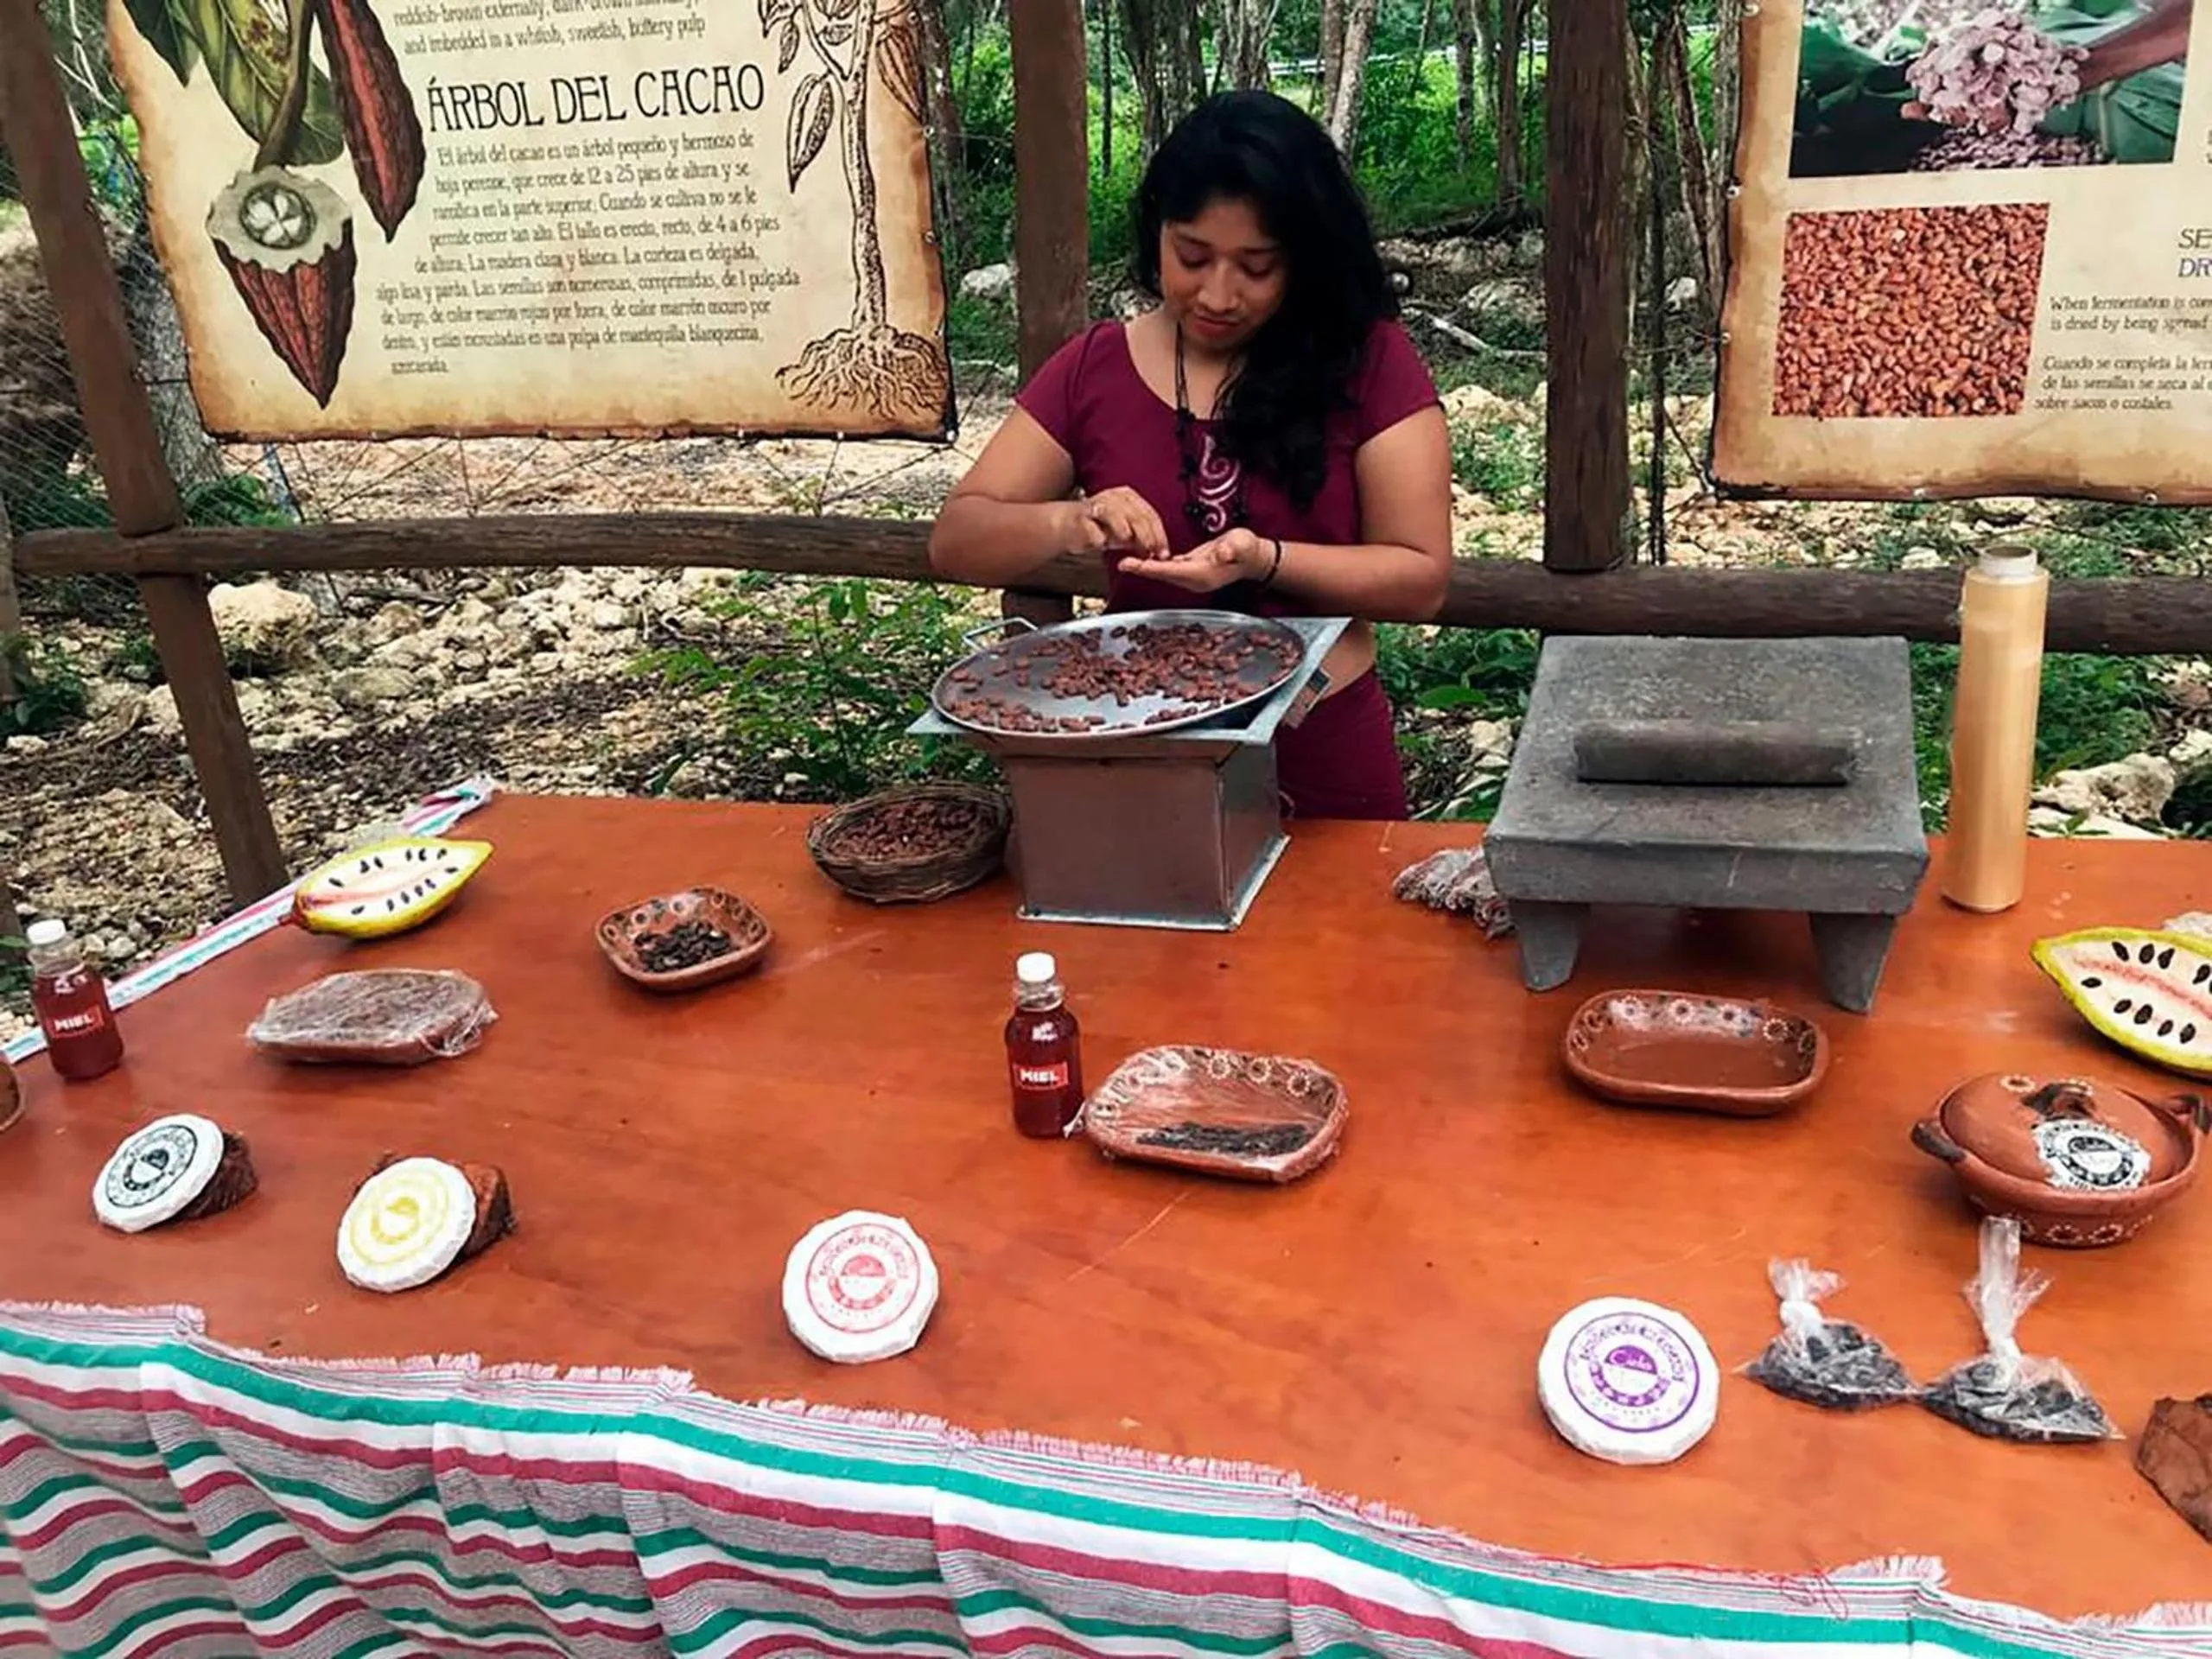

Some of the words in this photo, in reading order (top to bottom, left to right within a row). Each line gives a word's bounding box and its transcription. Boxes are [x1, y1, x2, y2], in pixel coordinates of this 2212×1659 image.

[404, 35, 427, 54] and
[627, 17, 673, 41] buttery
[677, 12, 705, 39] pulp
[427, 76, 544, 132] ÁRBOL
[550, 75, 626, 123] DEL
[634, 64, 765, 118] CACAO
[436, 146, 454, 166] El
[488, 143, 506, 162] del
[563, 144, 580, 159] un
[582, 137, 614, 157] árbol
[617, 135, 667, 160] pequeño
[669, 138, 679, 158] y
[681, 131, 735, 150] hermoso
[739, 128, 754, 147] de
[569, 168, 585, 185] de
[588, 166, 602, 184] 12
[615, 163, 635, 183] 25
[664, 161, 678, 180] de
[721, 163, 731, 182] y
[735, 162, 749, 176] se
[599, 191, 646, 211] Cuando
[650, 195, 662, 208] se
[557, 221, 573, 240] El
[603, 225, 618, 238] es
[697, 215, 714, 232] de
[715, 215, 726, 232] 4
[729, 219, 738, 232] a
[741, 213, 752, 232] 6
[754, 215, 781, 238] pies
[415, 255, 428, 274] de
[467, 253, 486, 270] La
[623, 246, 640, 264] La
[690, 248, 703, 261] es
[472, 279, 496, 297] Las
[721, 270, 737, 288] de
[749, 267, 801, 292] pulgada
[430, 305, 444, 323] de
[611, 299, 626, 317] de
[750, 302, 771, 320] por
[2050, 295, 2089, 311] When
[2091, 295, 2171, 310] fermentation
[2174, 296, 2185, 309] is
[602, 325, 618, 342] de
[2050, 319, 2062, 330] is
[2064, 316, 2098, 330] dried
[2102, 316, 2120, 334] by
[2123, 315, 2158, 334] being
[2043, 355, 2094, 371] Cuando
[2096, 359, 2111, 371] se
[2113, 356, 2171, 373] completa
[2176, 355, 2188, 370] la
[2042, 375, 2057, 391] de
[2060, 375, 2080, 391] las
[2083, 374, 2134, 391] semillas
[2139, 378, 2152, 391] se
[2157, 378, 2187, 391] seca
[2033, 397, 2069, 410] sobre
[2071, 398, 2107, 410] sacos
[2110, 399, 2120, 410] o
[54, 1014, 95, 1032] MIEL
[1020, 1068, 1060, 1083] MIEL
